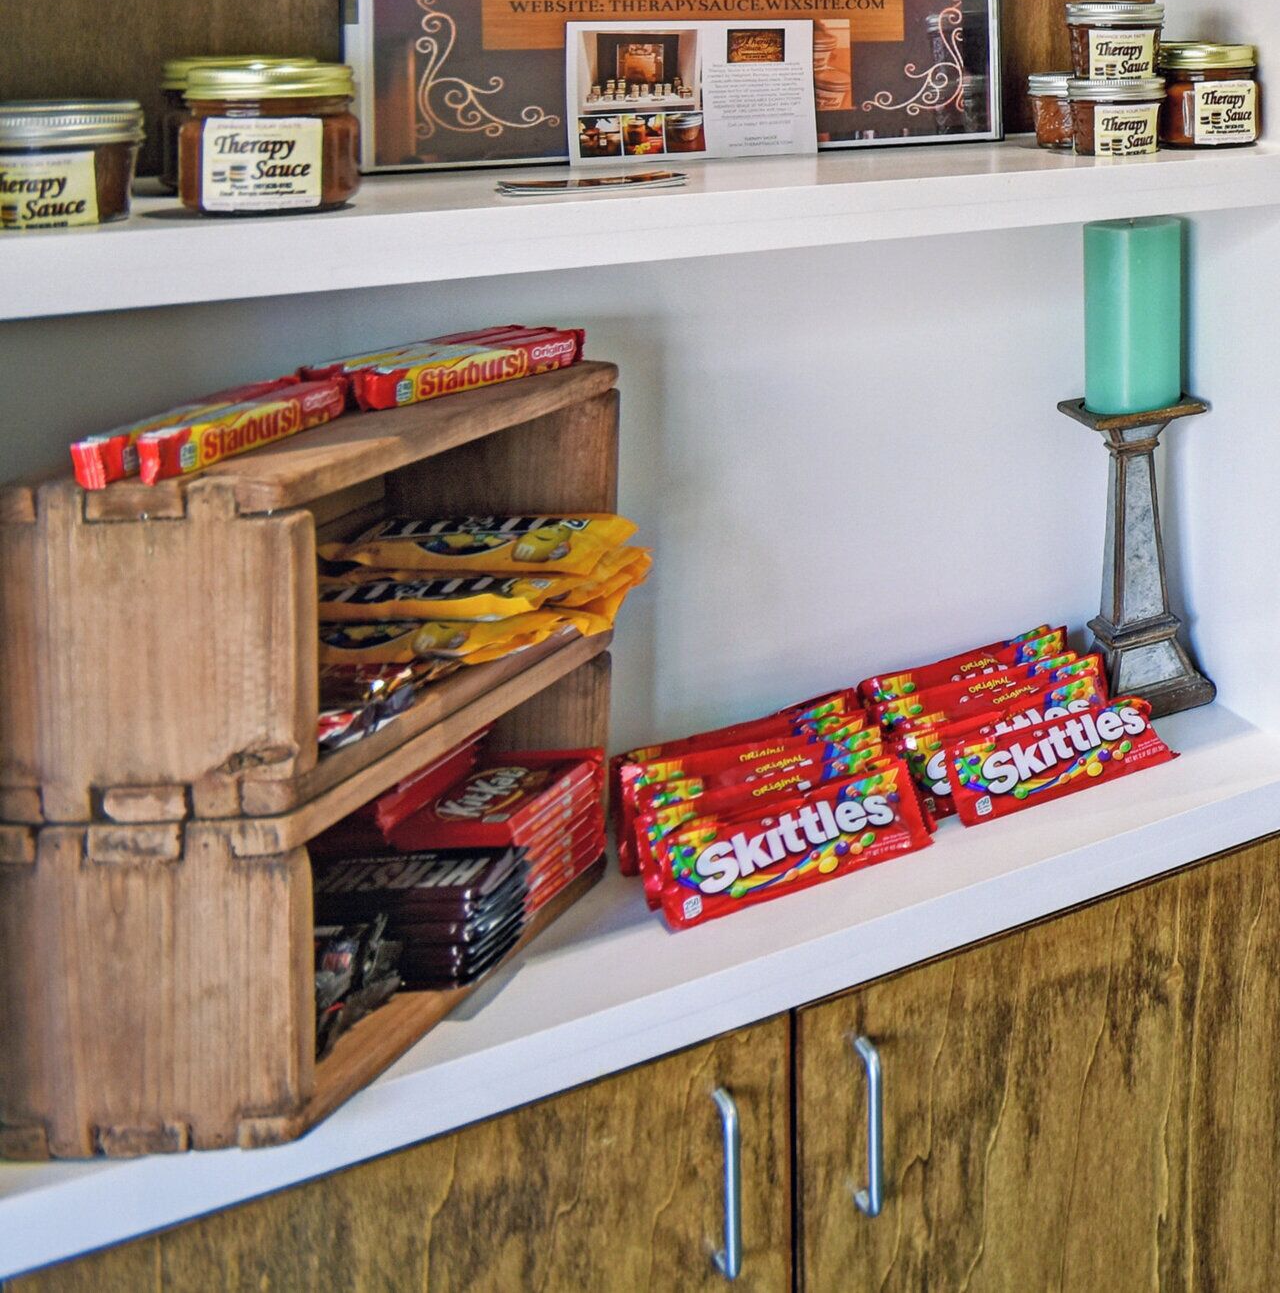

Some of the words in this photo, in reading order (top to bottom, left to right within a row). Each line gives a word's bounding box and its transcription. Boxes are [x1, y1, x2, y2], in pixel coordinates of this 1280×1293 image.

[509, 0, 604, 13] WEBSITE:
[1096, 41, 1143, 60] Therapy
[1119, 60, 1150, 75] Sauce
[1202, 90, 1246, 109] Therapy
[1102, 116, 1148, 135] Therapy
[1223, 110, 1252, 123] Sauce
[214, 133, 296, 160] Therapy
[1125, 135, 1154, 149] Sauce
[251, 160, 311, 180] Sauce
[22, 199, 86, 221] Sauce
[416, 349, 529, 397] Starburst
[530, 338, 576, 361] Original
[202, 399, 302, 460] Starburst
[981, 706, 1147, 795] Skittles
[695, 795, 895, 895] Skittles
